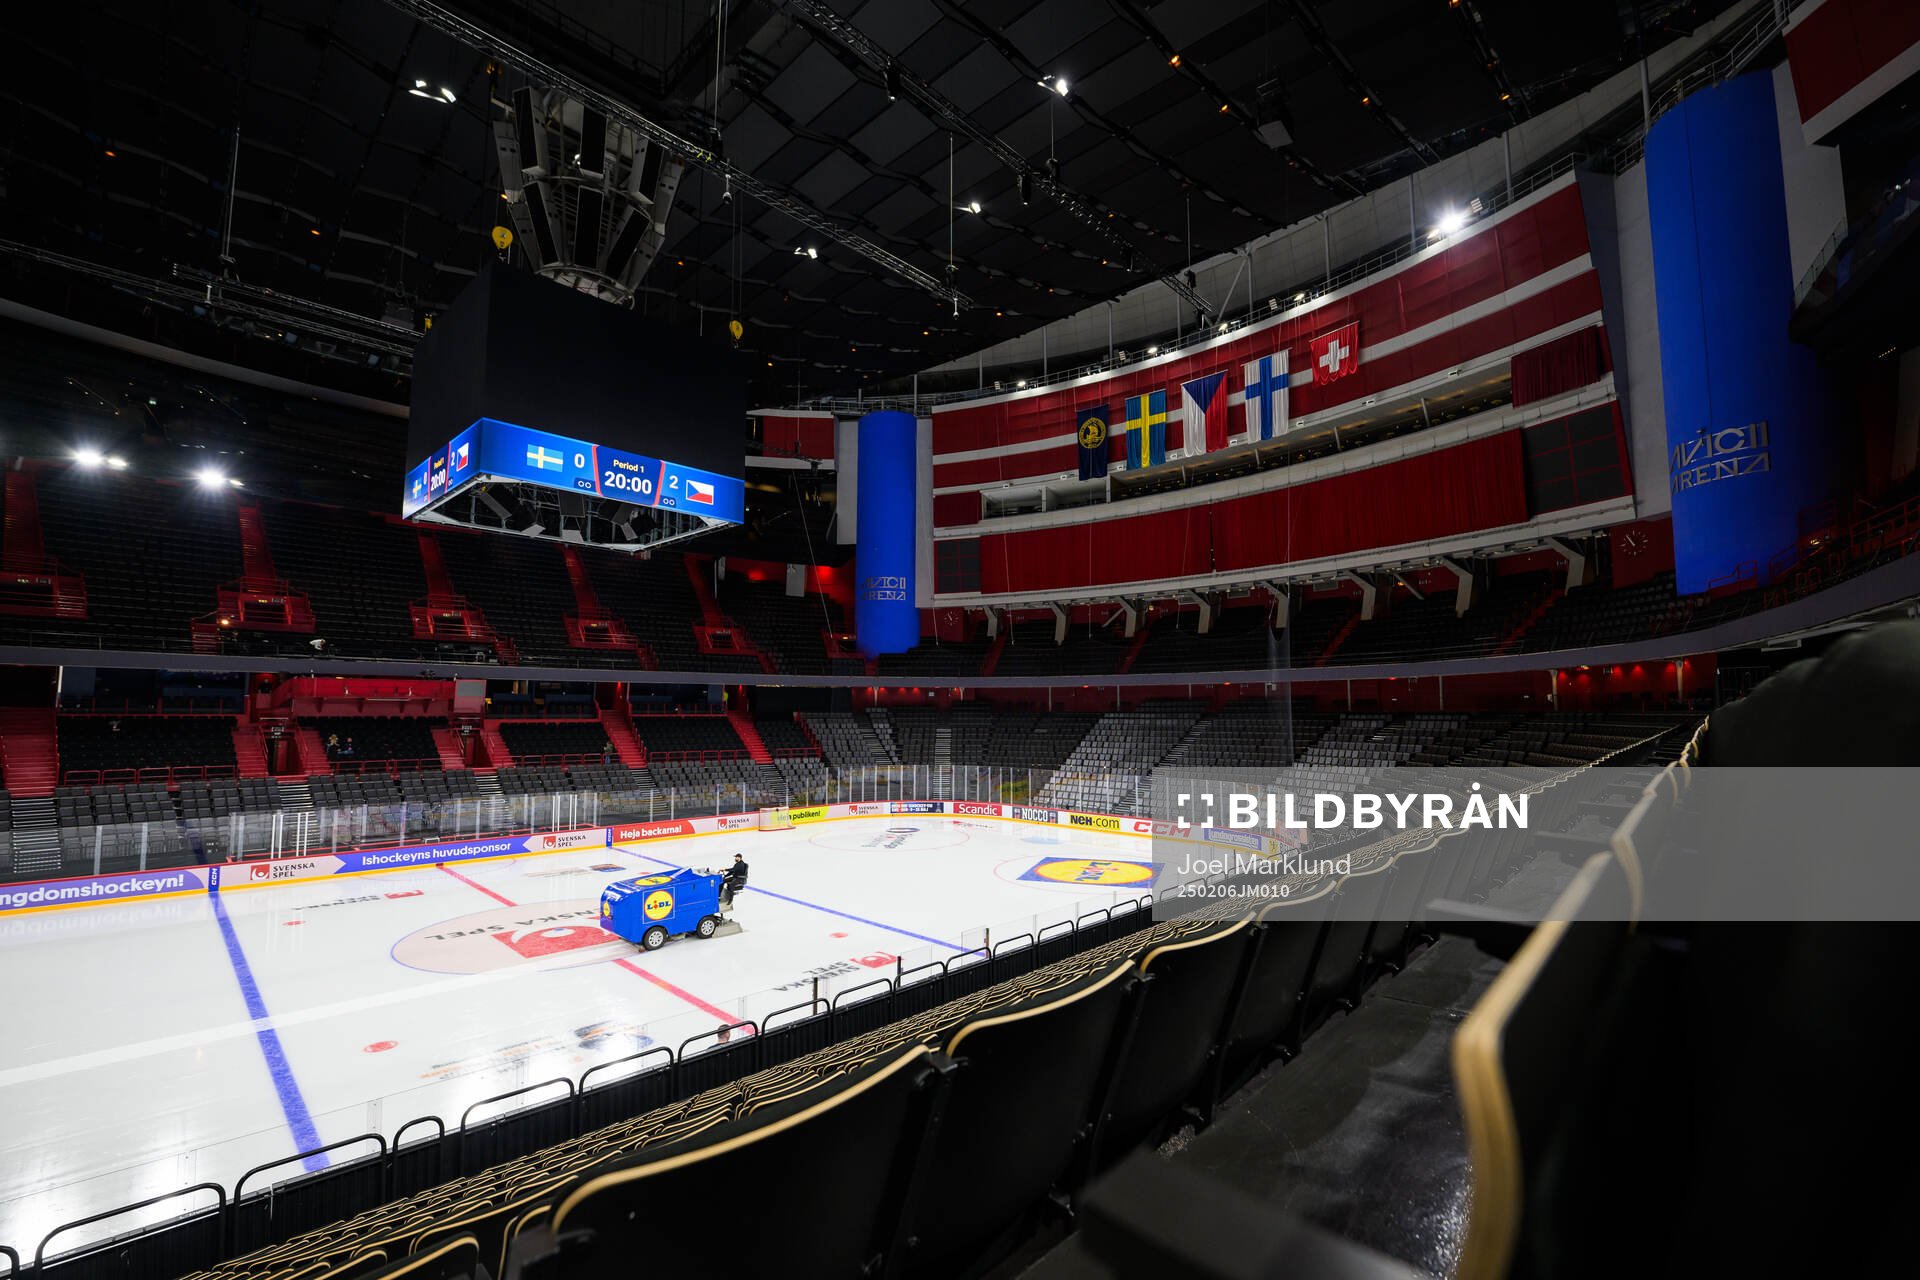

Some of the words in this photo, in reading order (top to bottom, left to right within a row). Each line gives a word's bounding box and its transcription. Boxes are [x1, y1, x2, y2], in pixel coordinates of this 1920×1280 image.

[574, 453, 585, 468] 0
[613, 459, 638, 472] Period
[604, 471, 652, 494] 20:00
[669, 475, 679, 489] 2
[793, 811, 821, 821] publiken!
[959, 804, 998, 816] Scandic
[1022, 808, 1048, 822] NOCCO
[620, 830, 640, 839] Heja
[641, 825, 682, 837] backarna!
[1133, 821, 1192, 838] CCM
[362, 852, 431, 866] Ishockeyns
[432, 842, 512, 858] huvudsponsor
[273, 862, 315, 872] SVENSKA
[0, 874, 184, 907] ngdomshockeyn!
